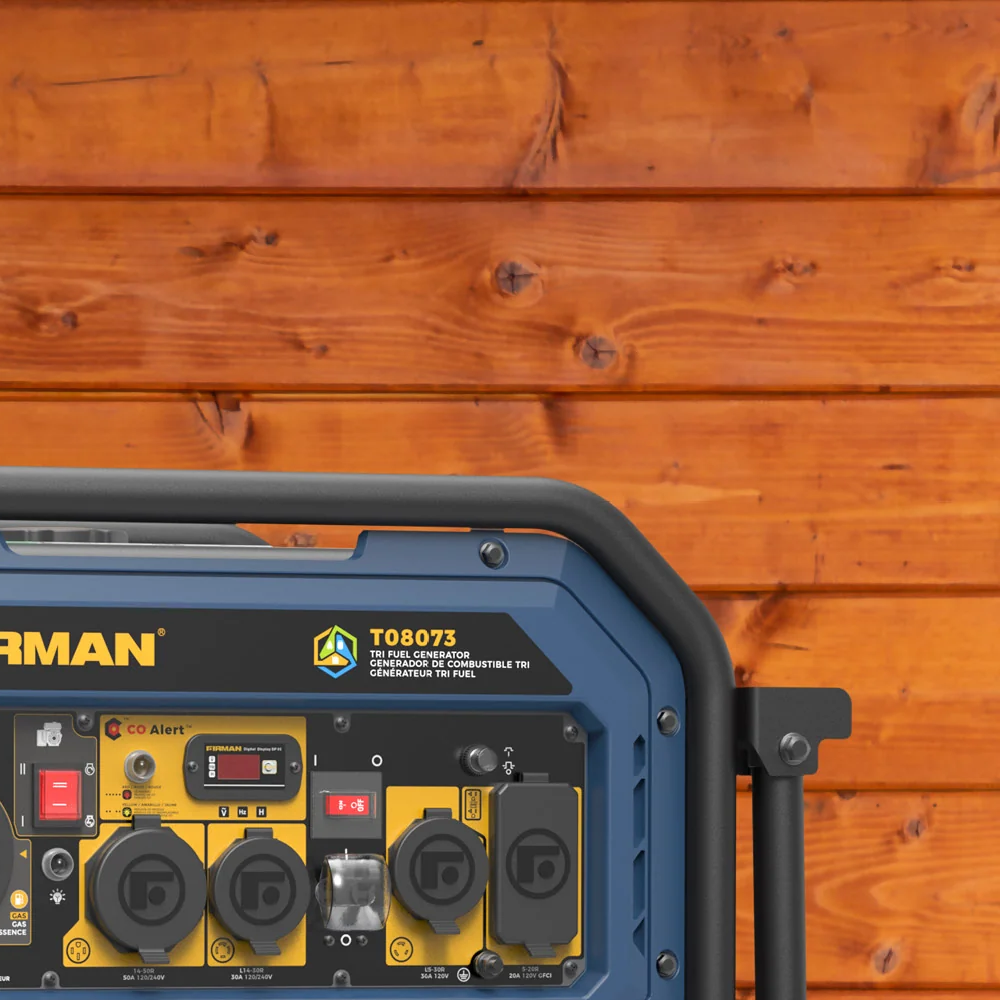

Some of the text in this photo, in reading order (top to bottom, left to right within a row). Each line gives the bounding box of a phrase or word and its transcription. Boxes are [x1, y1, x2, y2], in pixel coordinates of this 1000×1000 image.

[370, 628, 456, 646] T08073
[370, 650, 470, 659] TRI FUEL GENERATOR
[370, 660, 530, 669] GENERADOR DE COMBUSTIBLE TRI
[370, 668, 432, 678] GÉNÉRATEUR
[453, 670, 476, 678] FUEL
[127, 725, 146, 734] CO
